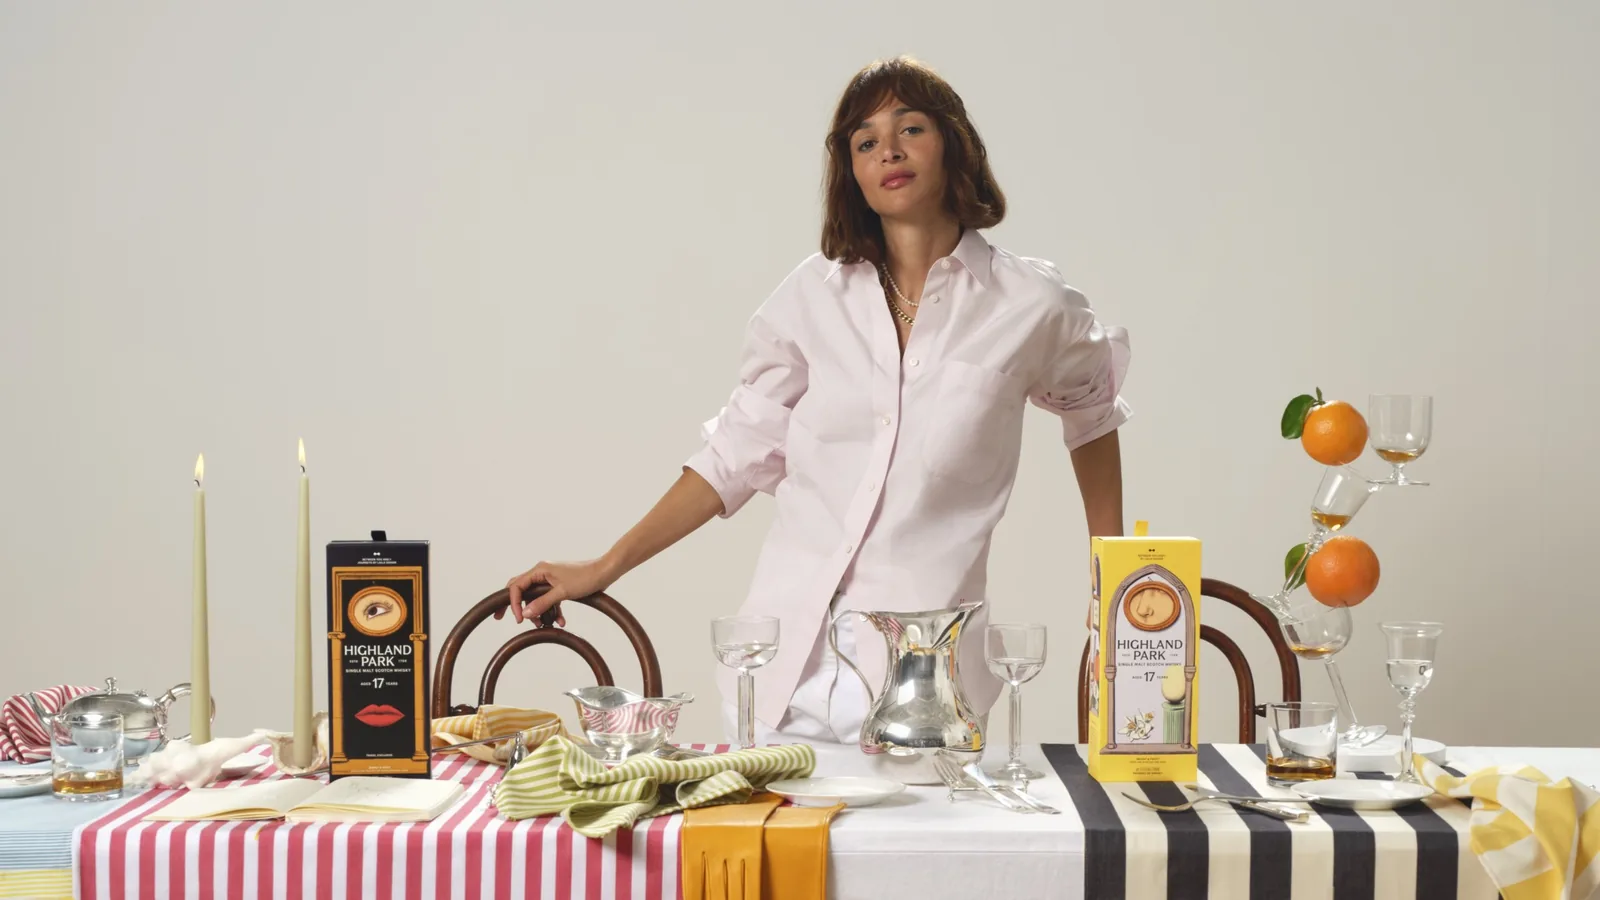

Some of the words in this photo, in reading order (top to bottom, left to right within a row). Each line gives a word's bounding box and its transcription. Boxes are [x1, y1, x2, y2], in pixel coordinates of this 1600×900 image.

[1117, 639, 1183, 650] HIGHLAND
[344, 645, 412, 656] HIGHLAND
[1133, 650, 1166, 660] PARK
[361, 656, 395, 667] PARK
[1143, 671, 1156, 682] 17
[372, 677, 385, 689] 17
